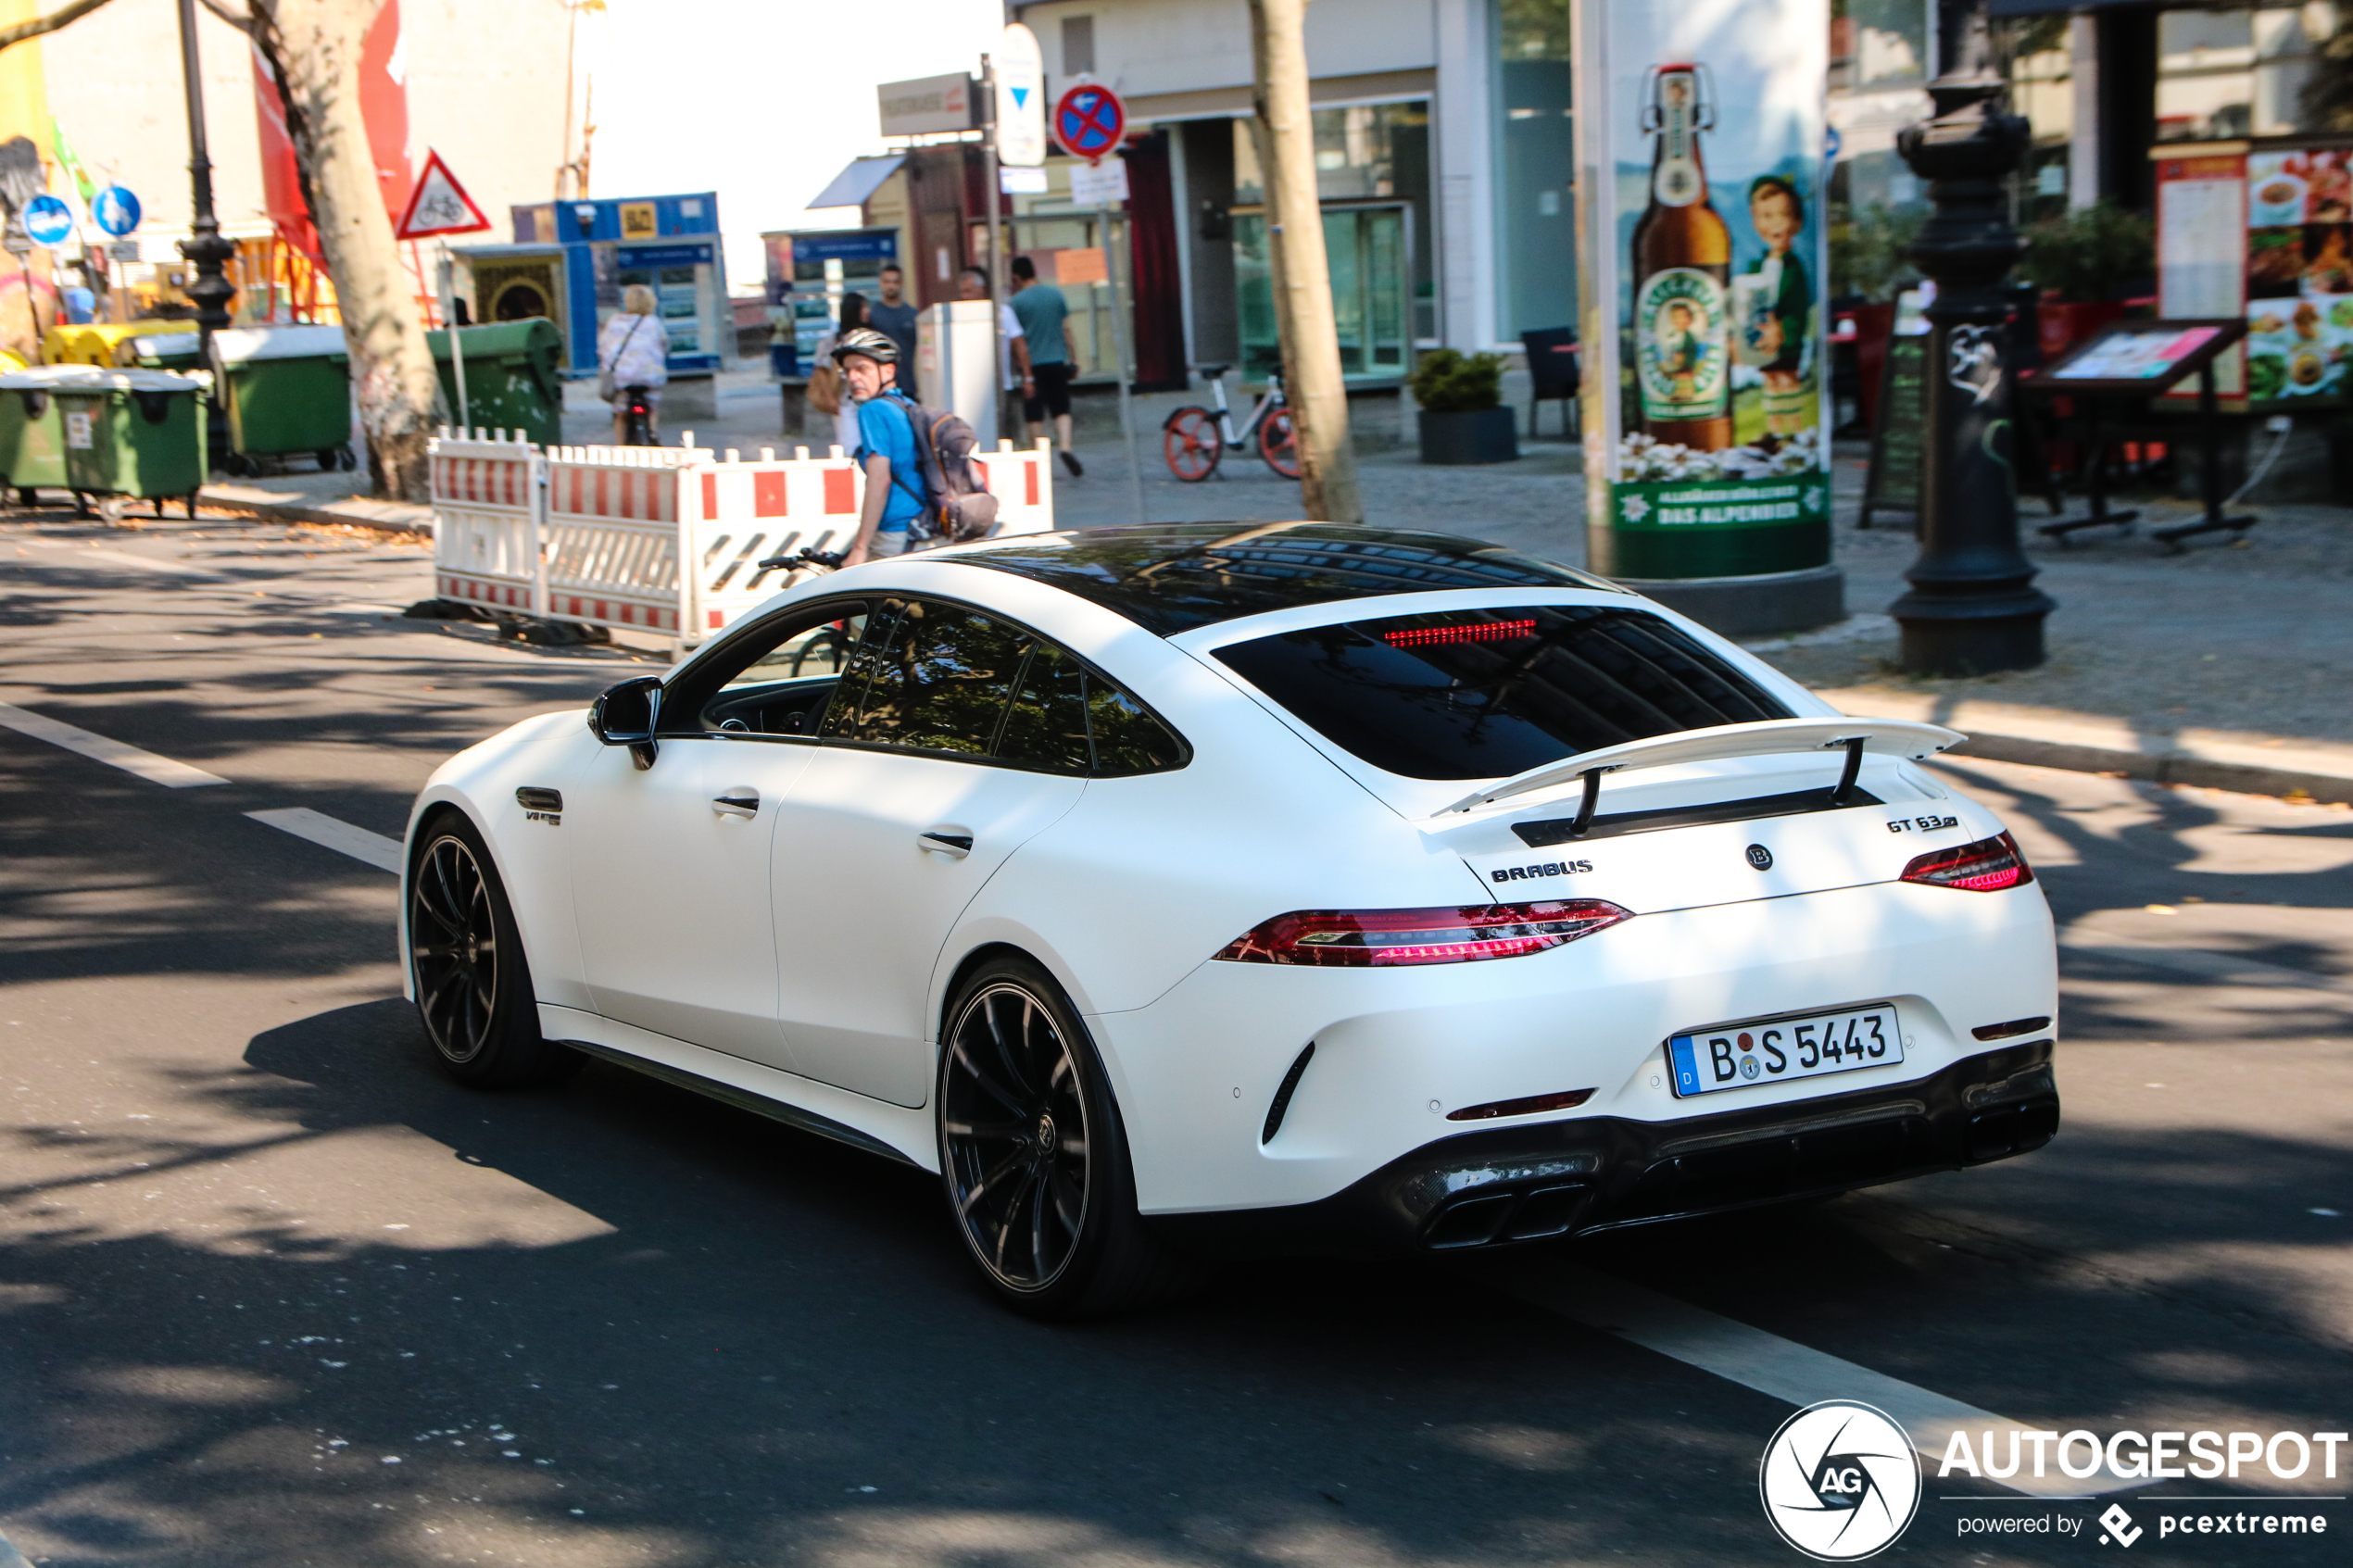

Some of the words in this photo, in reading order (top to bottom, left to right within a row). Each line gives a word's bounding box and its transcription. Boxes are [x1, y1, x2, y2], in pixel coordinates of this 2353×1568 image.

[1886, 819, 1911, 834] GT
[1915, 815, 1943, 829] 63
[1491, 859, 1593, 883] BRABUS
[1708, 1037, 1737, 1083] B
[1762, 1030, 1787, 1074] S
[1793, 1015, 1886, 1069] 5443
[1682, 1072, 1692, 1085] D
